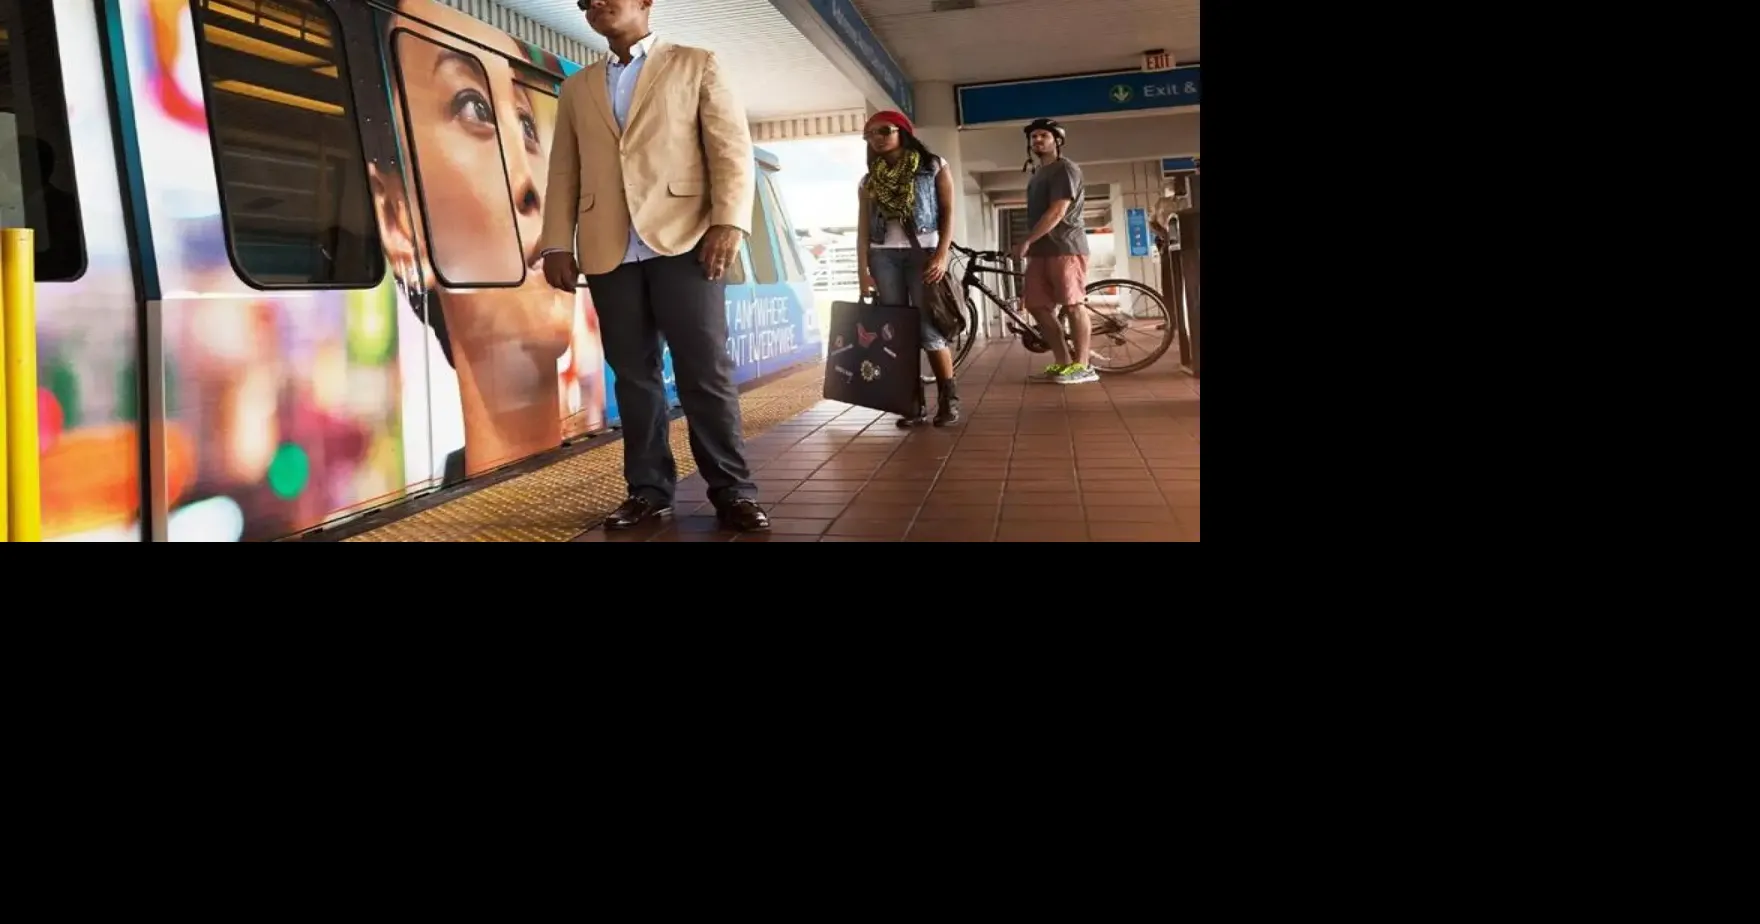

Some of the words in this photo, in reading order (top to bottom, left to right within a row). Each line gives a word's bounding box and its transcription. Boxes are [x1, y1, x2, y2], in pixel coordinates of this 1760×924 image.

[1146, 53, 1173, 70] EXIT
[1143, 84, 1179, 97] Exit
[1184, 81, 1197, 94] &
[735, 296, 789, 331] ANYWHERE
